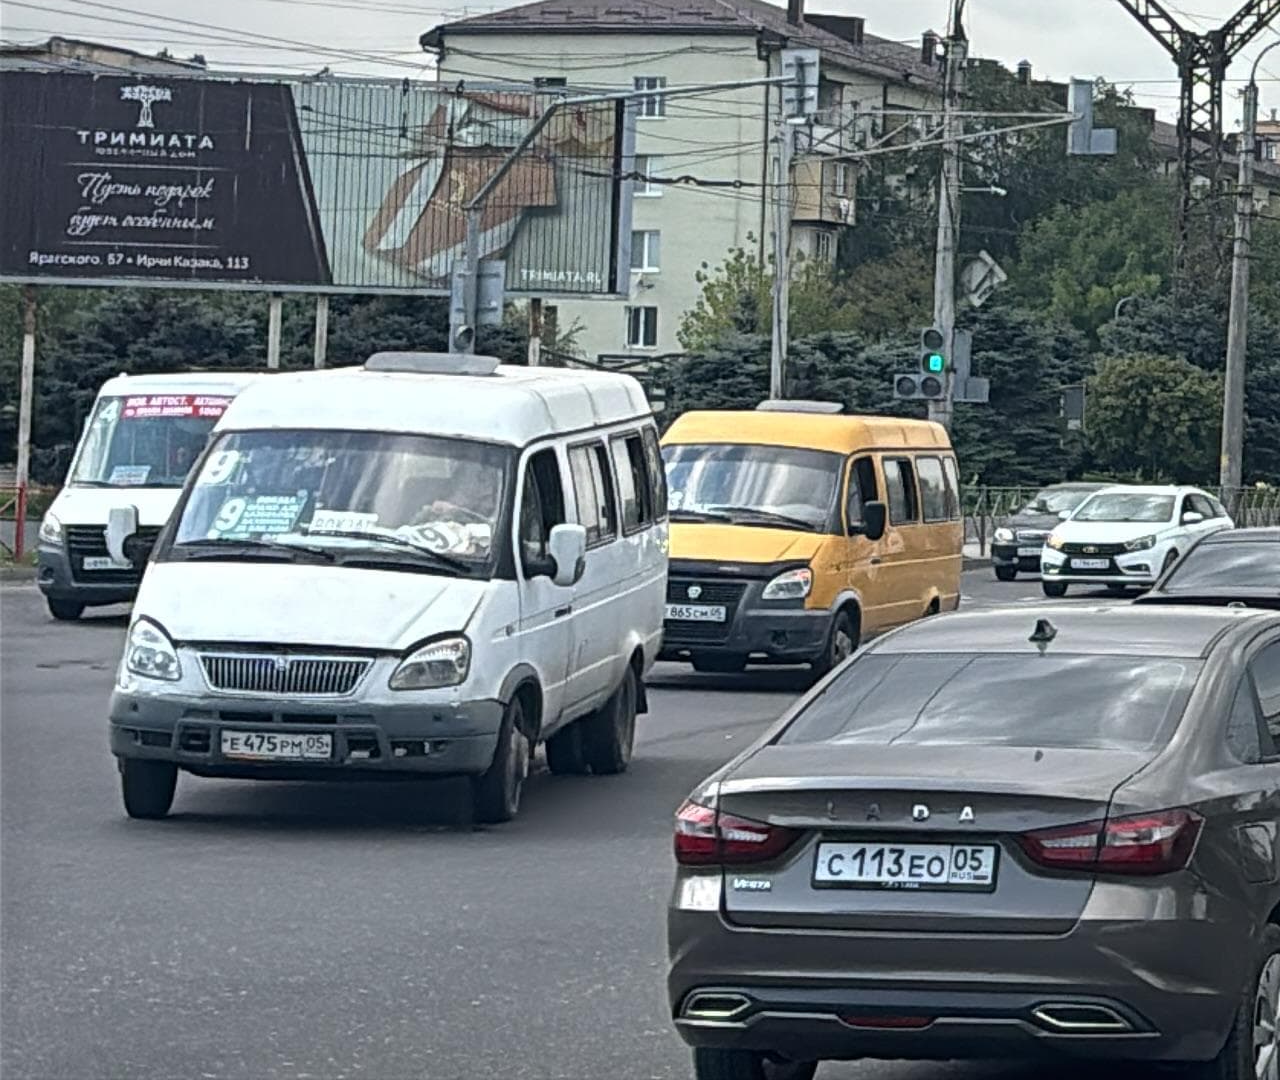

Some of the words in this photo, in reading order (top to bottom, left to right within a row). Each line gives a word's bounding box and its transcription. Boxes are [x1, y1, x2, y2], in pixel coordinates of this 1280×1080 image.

[76, 130, 214, 150] ТРИМИАТА
[226, 256, 249, 270] 113
[99, 399, 119, 423] 4
[202, 449, 241, 485] 9
[214, 497, 247, 532] 9
[826, 801, 976, 823] LADA
[953, 848, 984, 871] 05
[950, 871, 973, 880] RUS
